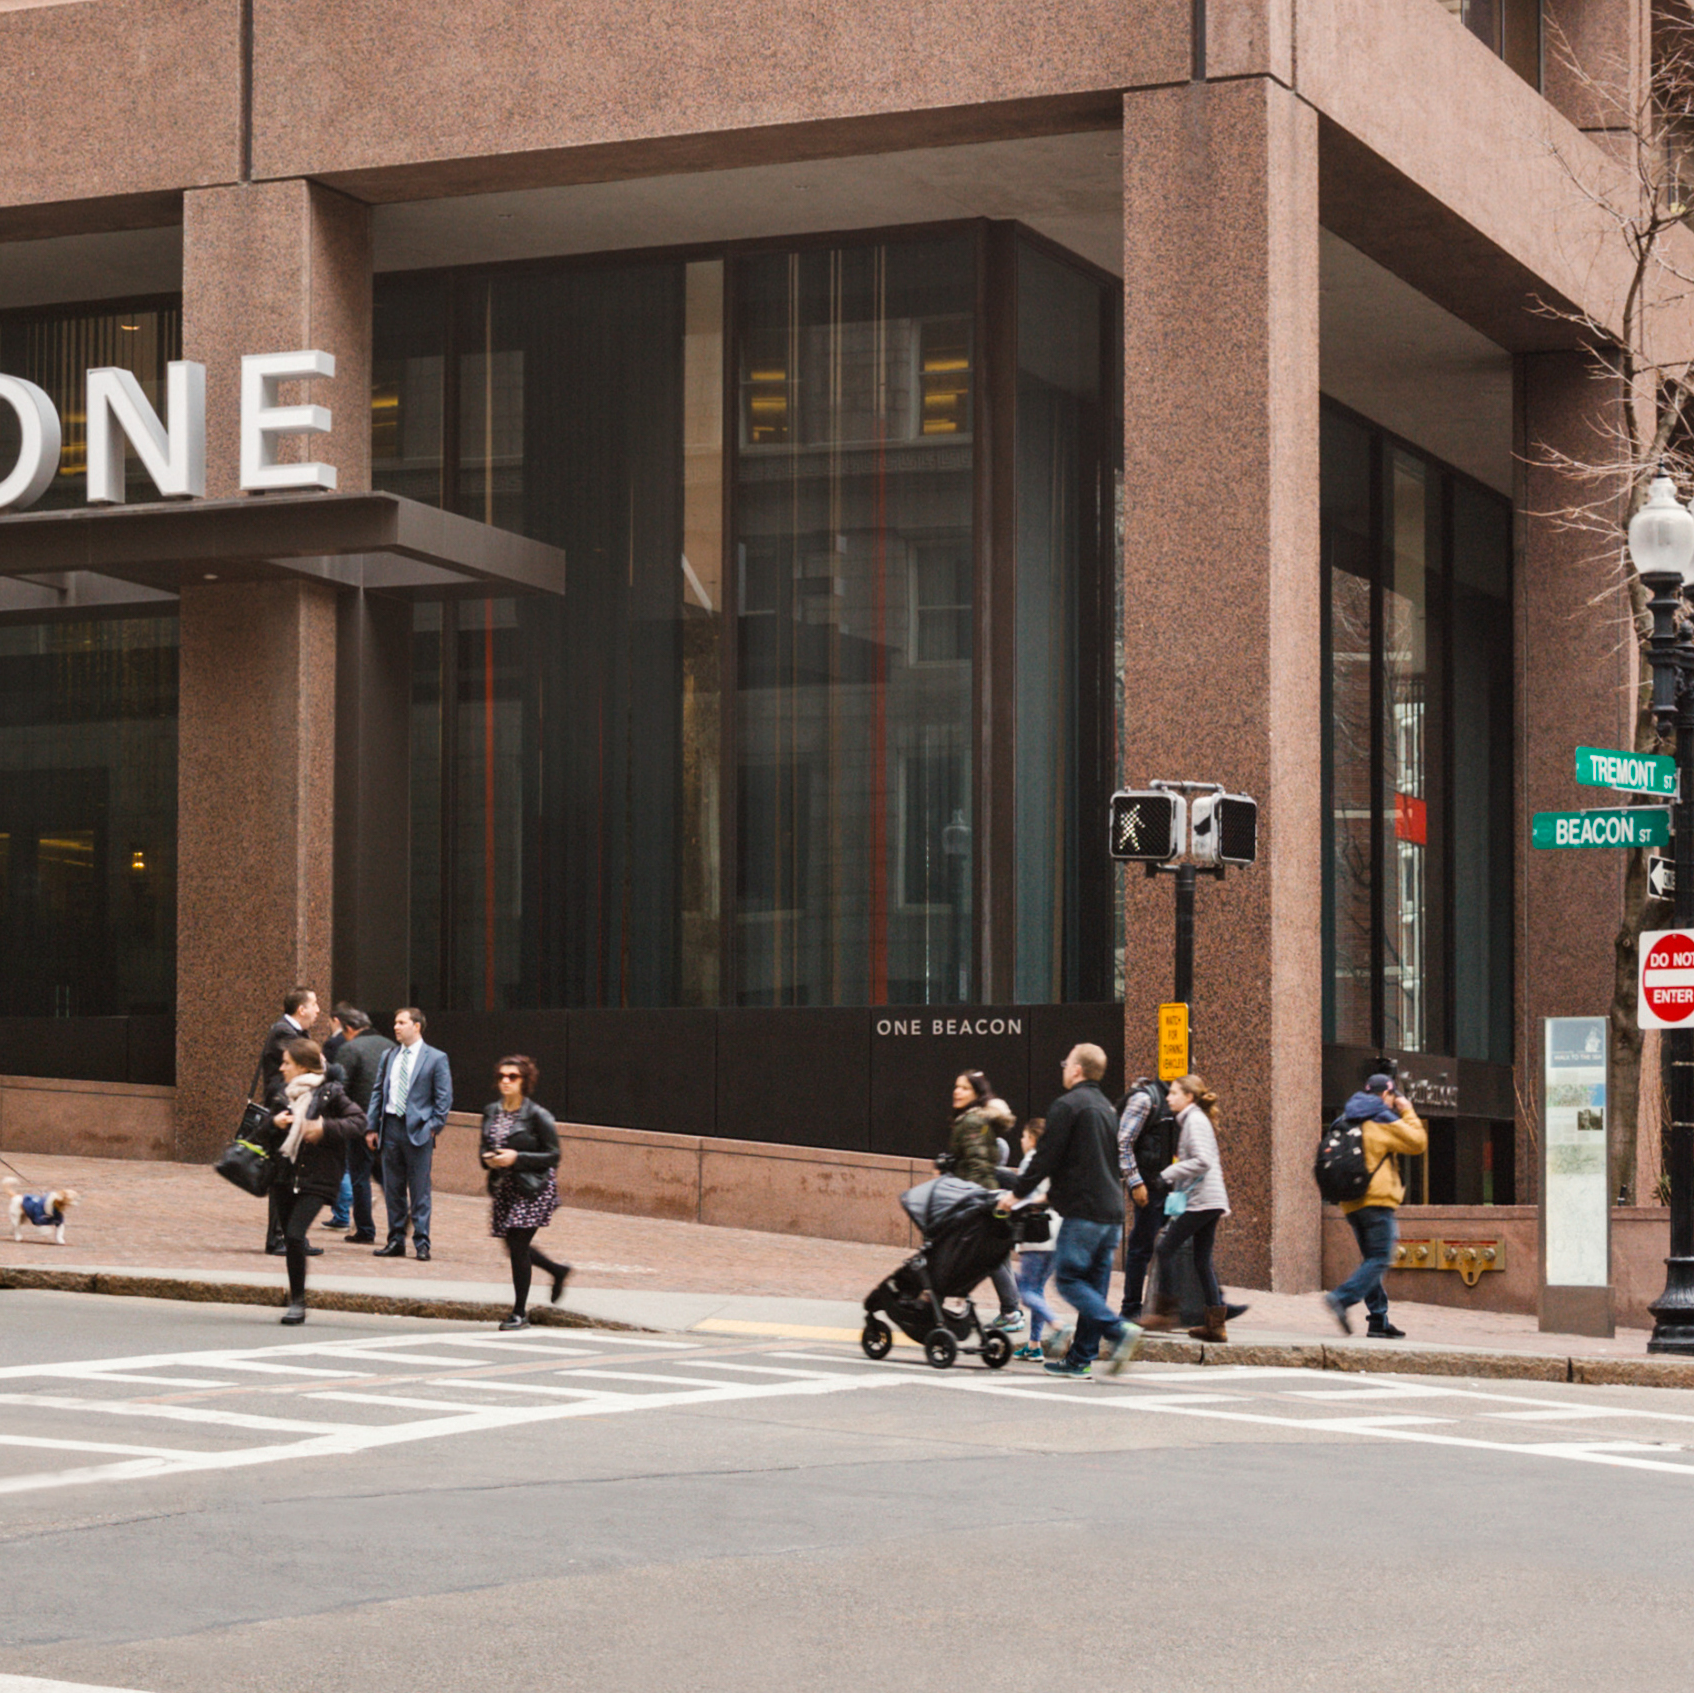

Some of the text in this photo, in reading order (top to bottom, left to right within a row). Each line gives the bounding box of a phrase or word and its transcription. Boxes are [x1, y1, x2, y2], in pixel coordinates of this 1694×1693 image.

[1590, 755, 1673, 789] TREMONT ST
[1556, 817, 1652, 845] BEACON ST
[1650, 953, 1669, 967] DO
[1653, 988, 1694, 1004] ENTER
[876, 1019, 1022, 1035] ONE BEACON
[1165, 1015, 1182, 1025] WATCH
[1168, 1030, 1178, 1040] FOR
[1164, 1044, 1183, 1055] TURNING
[1163, 1058, 1185, 1069] VEHICLES
